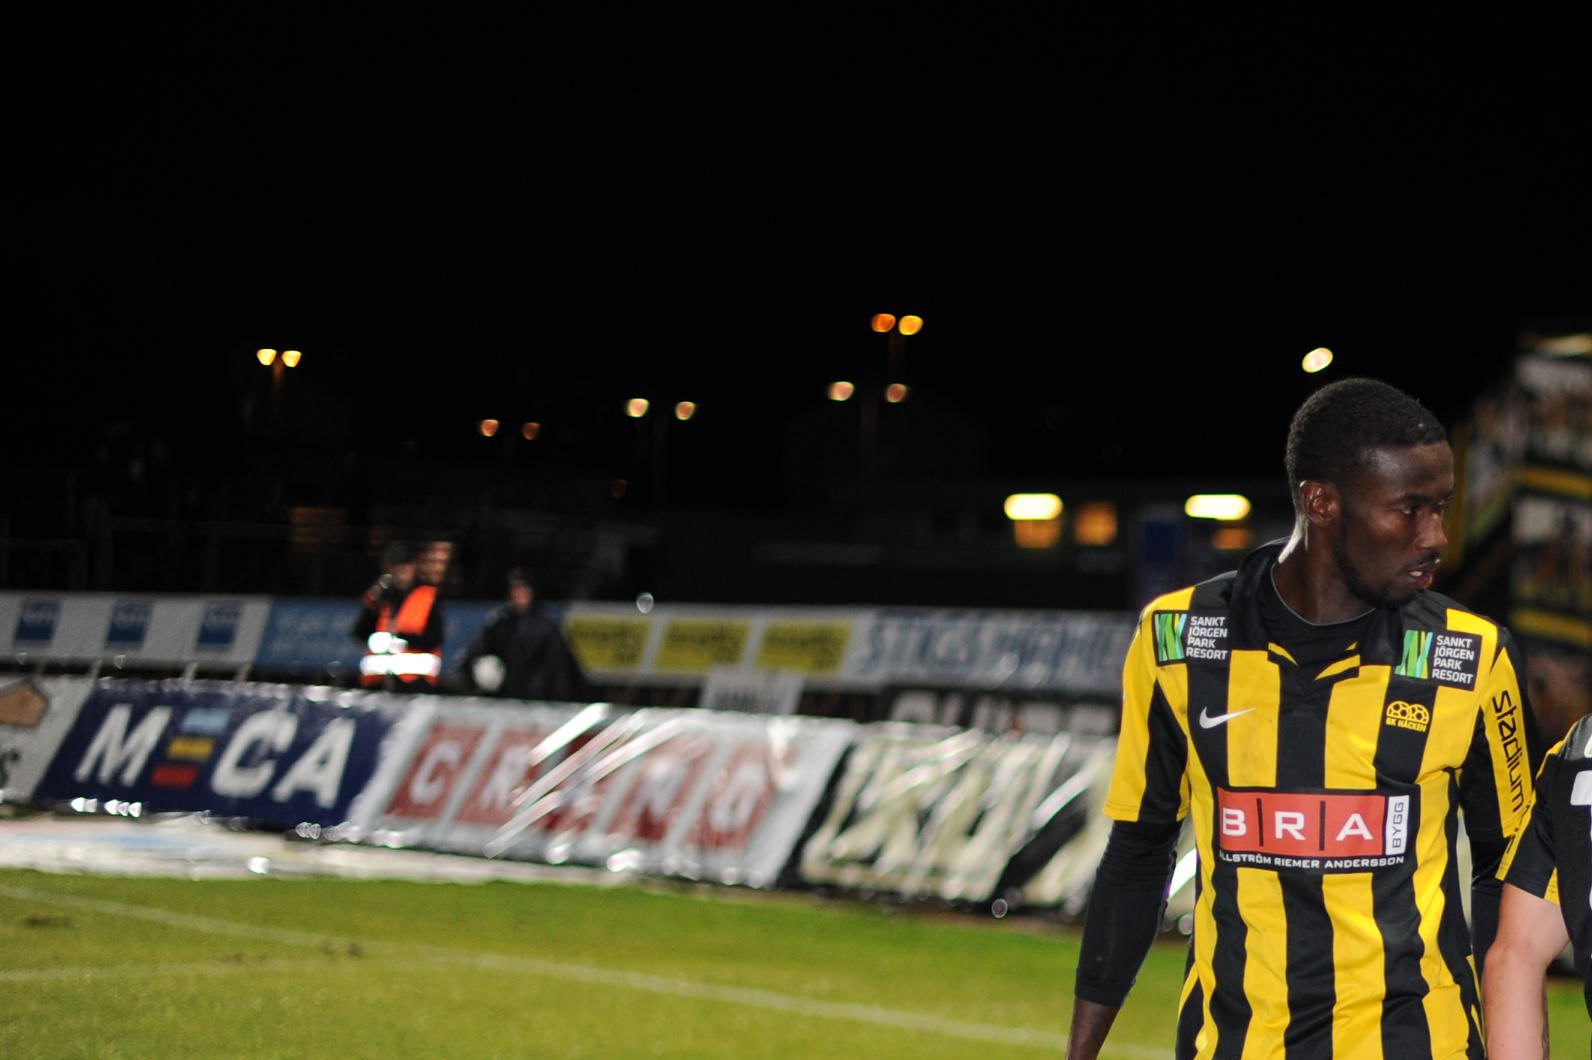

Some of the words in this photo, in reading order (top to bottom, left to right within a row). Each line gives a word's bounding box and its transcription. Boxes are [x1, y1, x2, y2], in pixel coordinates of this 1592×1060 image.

[1190, 616, 1226, 627] SANKT
[1188, 627, 1228, 638] JÖRGEN
[1187, 637, 1217, 648] PARK
[1437, 635, 1472, 648] SANKT
[1185, 647, 1229, 660] RESORT
[1435, 647, 1474, 660] JÖRGEN
[1433, 658, 1462, 670] PARK
[1431, 669, 1473, 684] RESORT
[1492, 689, 1525, 814] stadium
[1392, 801, 1404, 849] BYGG
[1273, 856, 1320, 869] RIEMER
[1324, 856, 1405, 869] ANDERSSON
